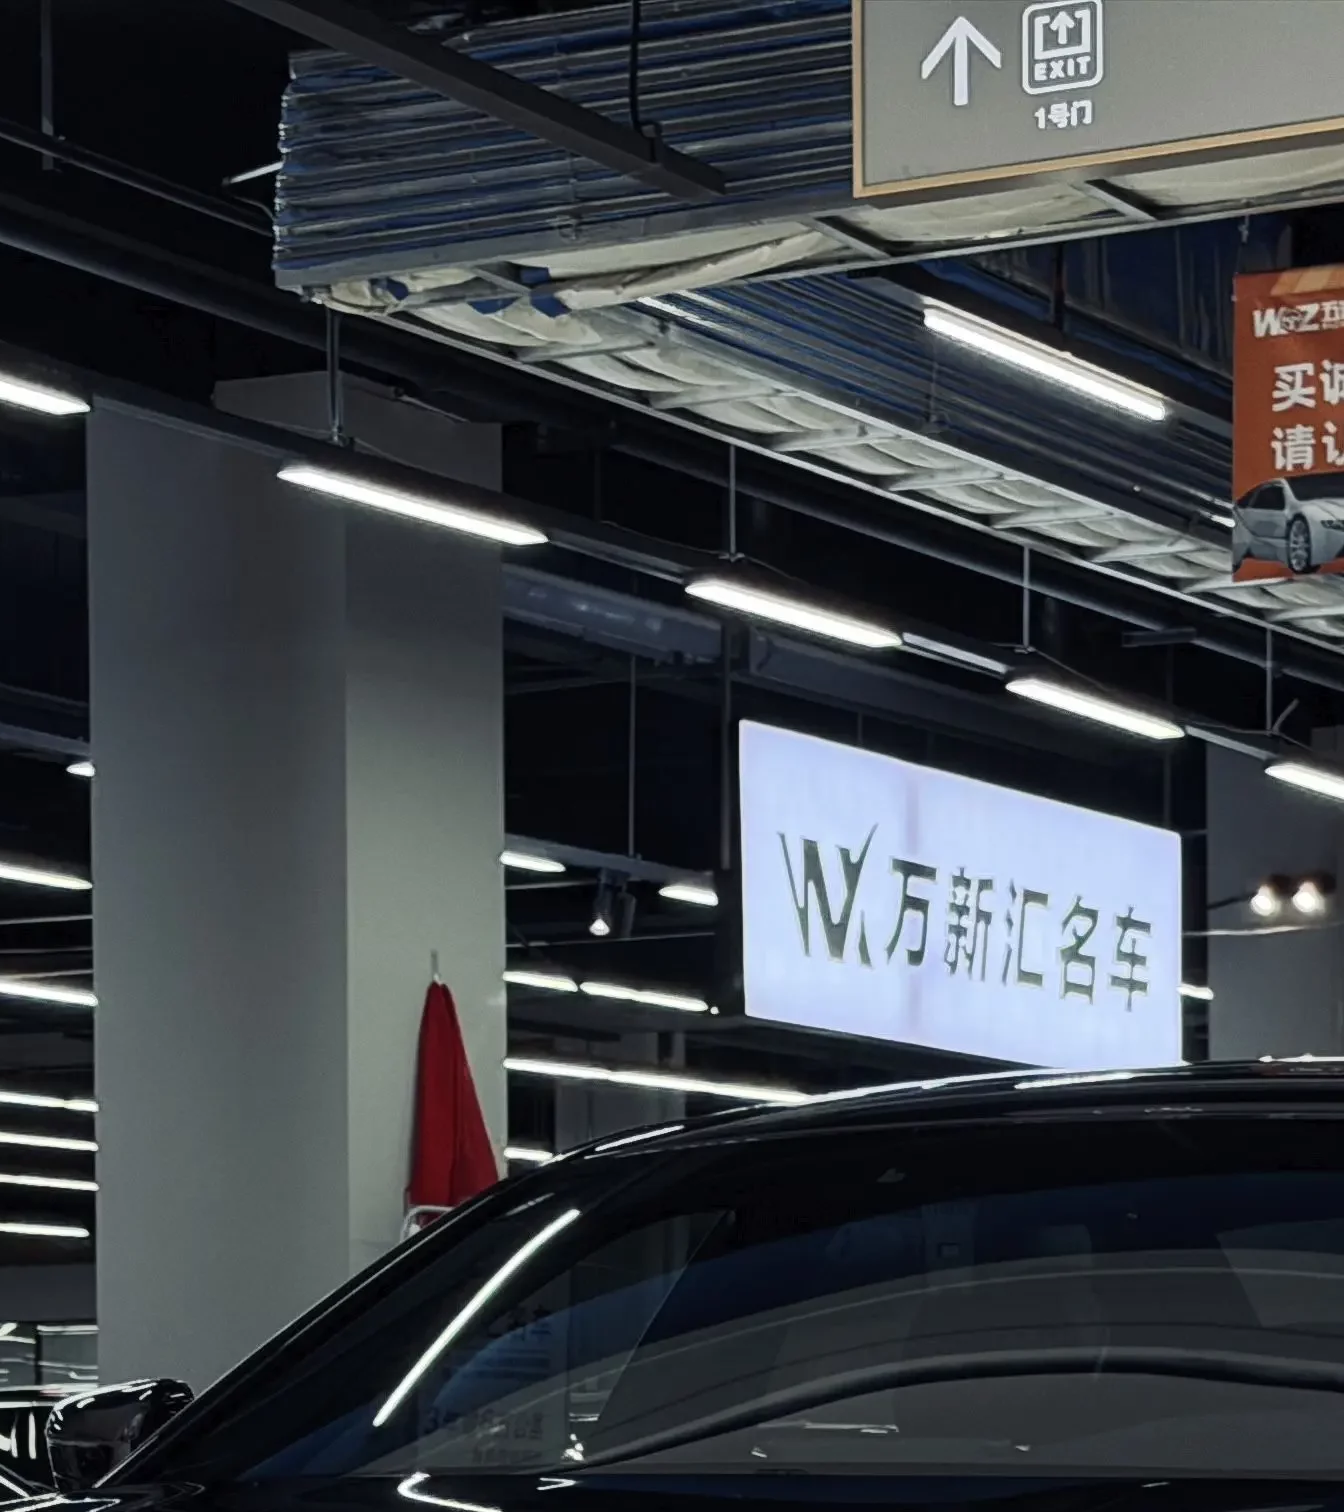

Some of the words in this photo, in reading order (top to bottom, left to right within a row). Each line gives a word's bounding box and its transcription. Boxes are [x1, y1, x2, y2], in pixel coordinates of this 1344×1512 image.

[1034, 56, 1091, 81] EXIT
[1034, 100, 1092, 129] 1号门
[884, 856, 1153, 1013] 万新汇名车
